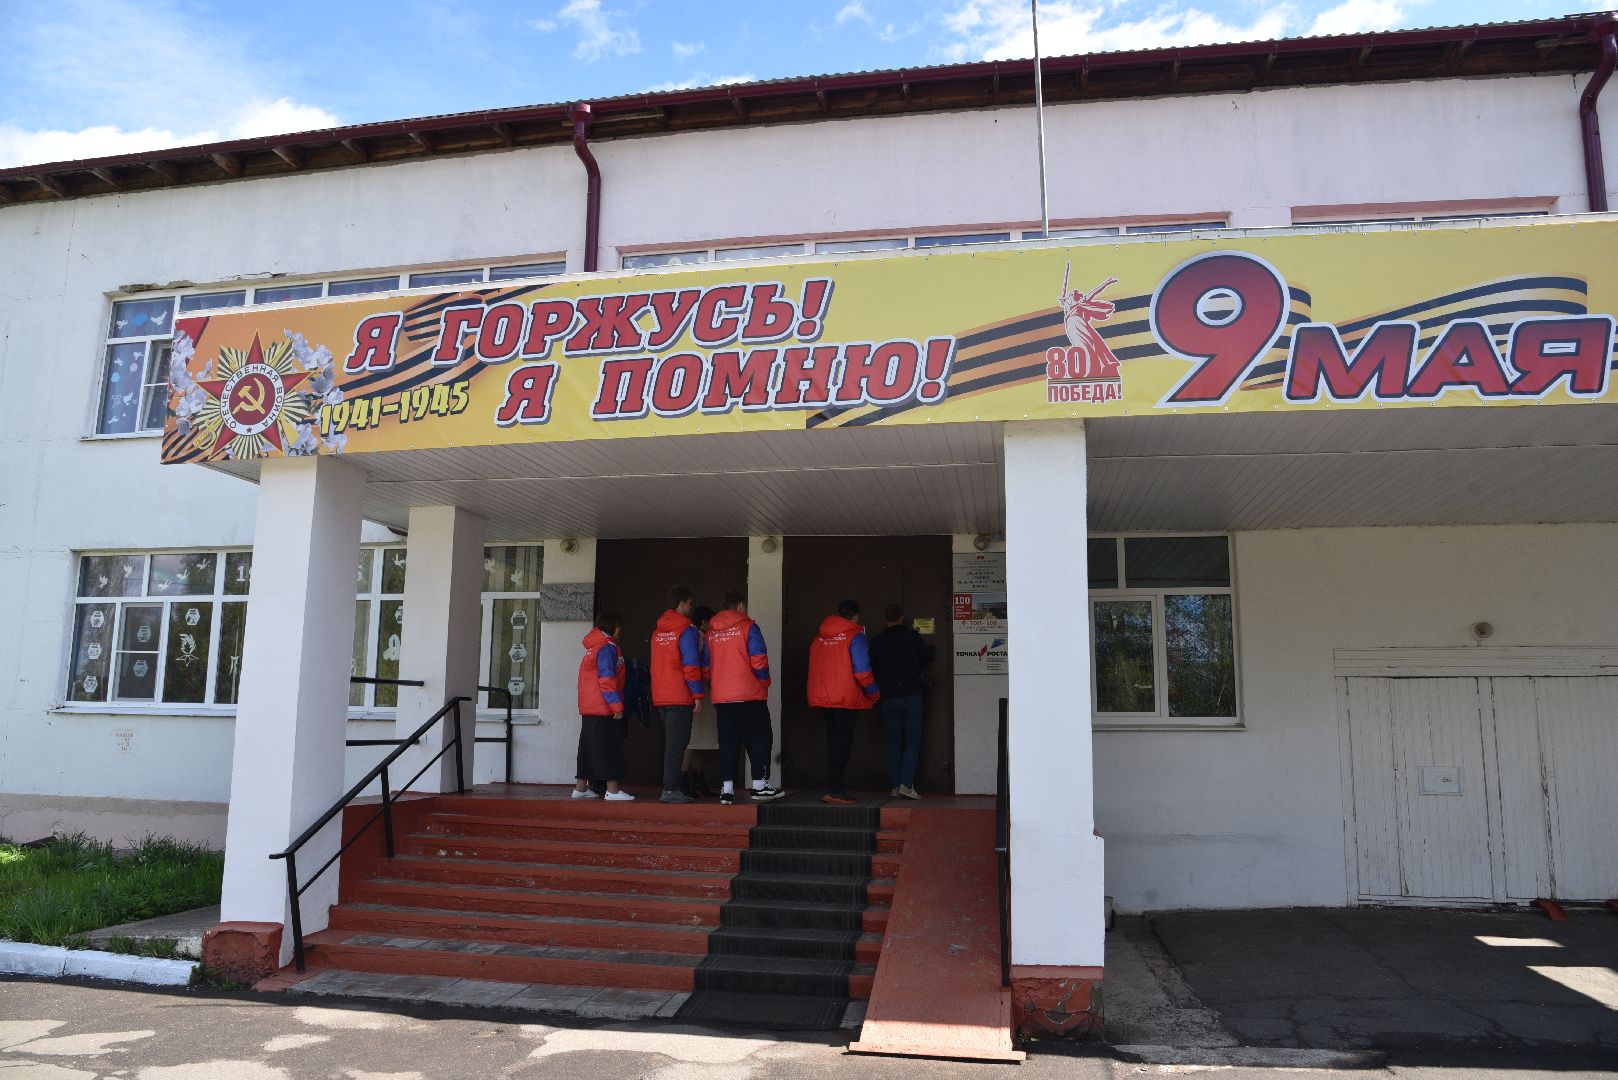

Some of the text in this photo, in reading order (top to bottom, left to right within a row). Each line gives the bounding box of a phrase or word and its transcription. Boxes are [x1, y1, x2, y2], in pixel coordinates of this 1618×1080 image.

[345, 278, 833, 373] Я ГОРЖУСЬ!
[1149, 250, 1616, 408] 9 МАЯ
[495, 336, 955, 425] Я ПОМНЮ!
[1047, 347, 1087, 379] 80
[222, 365, 280, 429] ОТЕЧЕСТВЕННАЯ
[321, 380, 470, 437] 1941-1945
[1047, 384, 1122, 403] ПОБЕДА!
[954, 596, 971, 605] 100
